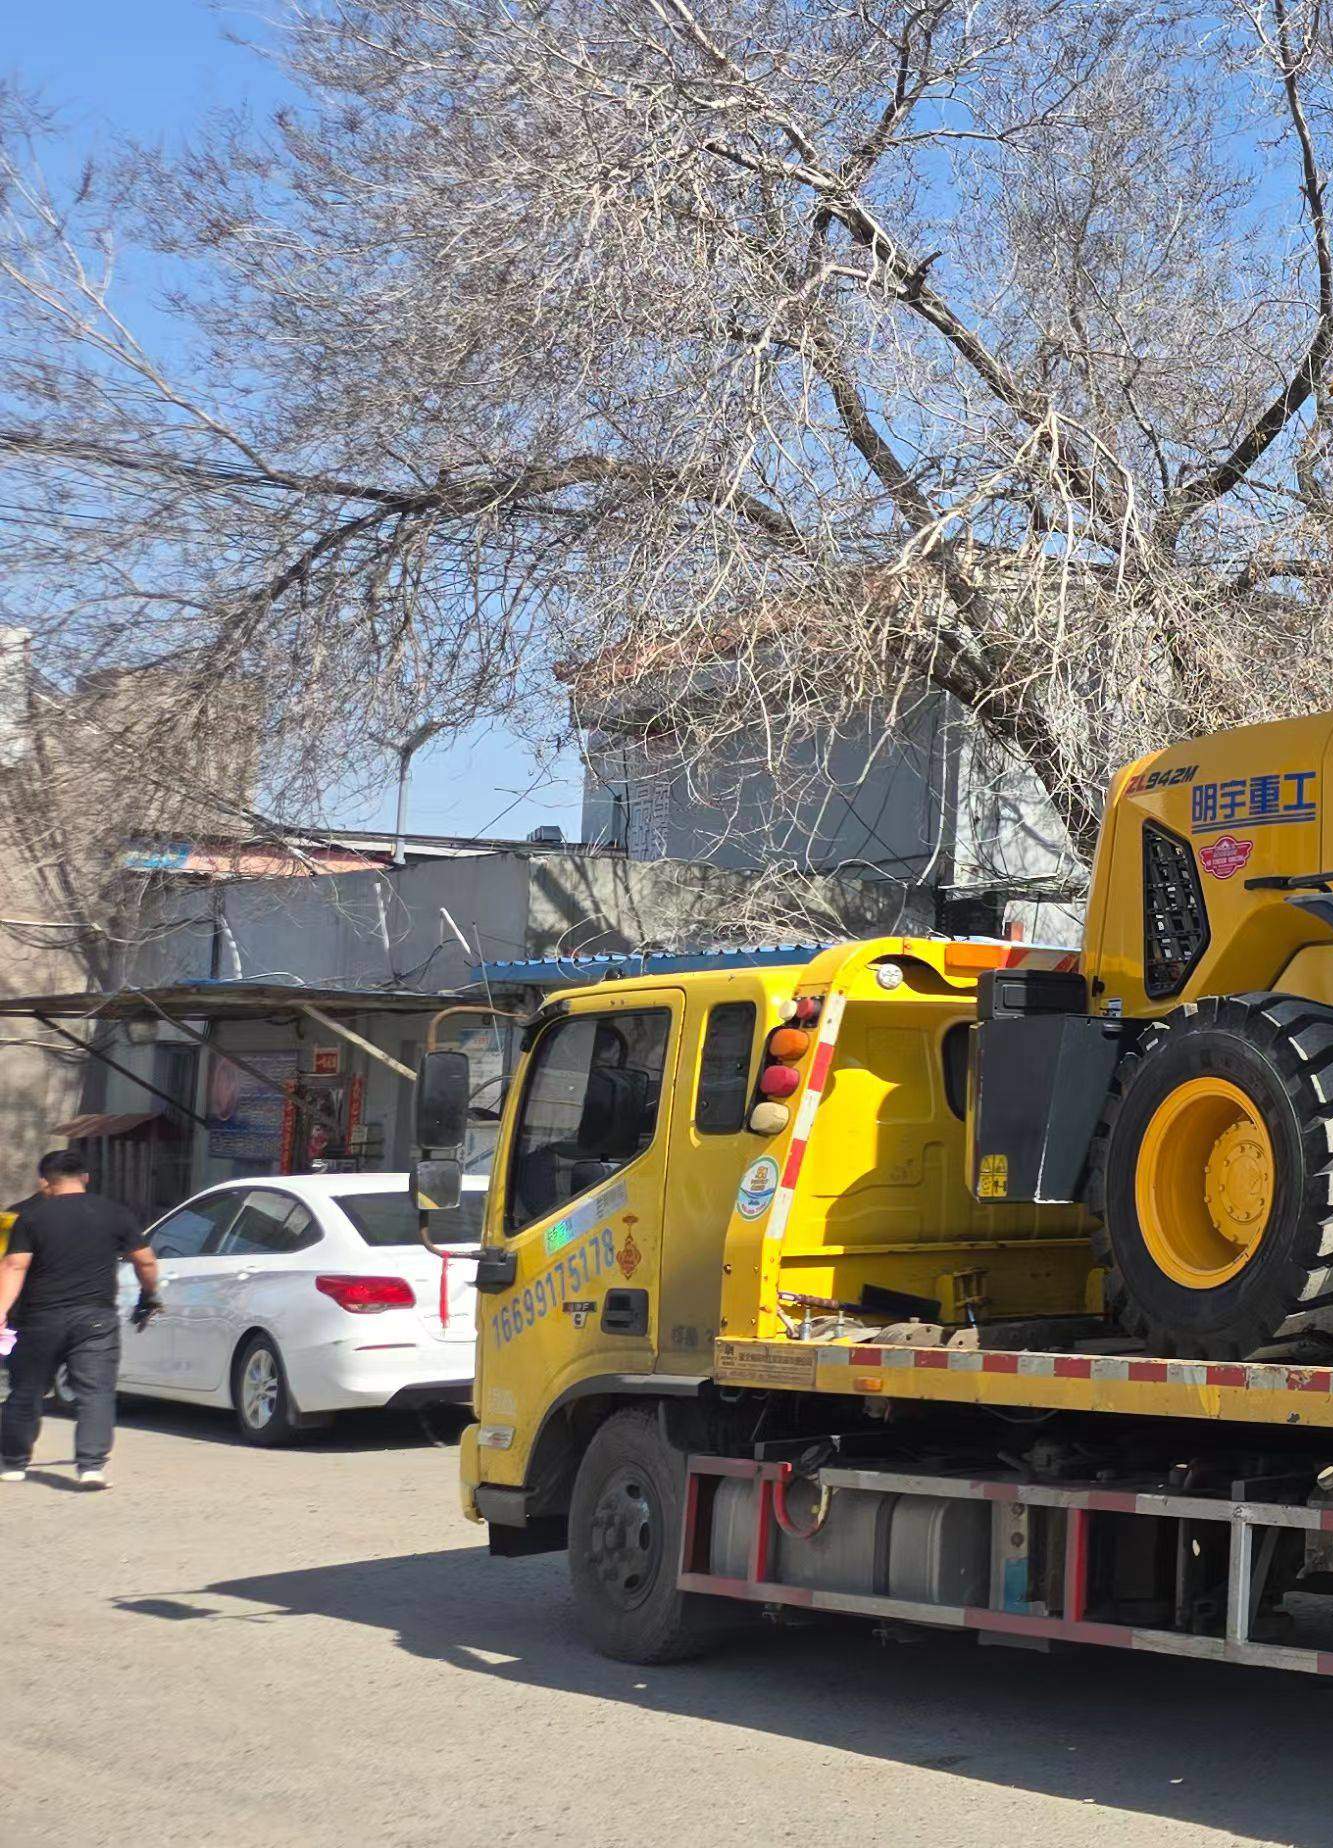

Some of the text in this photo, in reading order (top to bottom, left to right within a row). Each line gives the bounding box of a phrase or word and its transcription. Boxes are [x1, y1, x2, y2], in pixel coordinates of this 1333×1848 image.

[1191, 771, 1317, 822] 明宇重工
[492, 1228, 614, 1347] 16699175178
